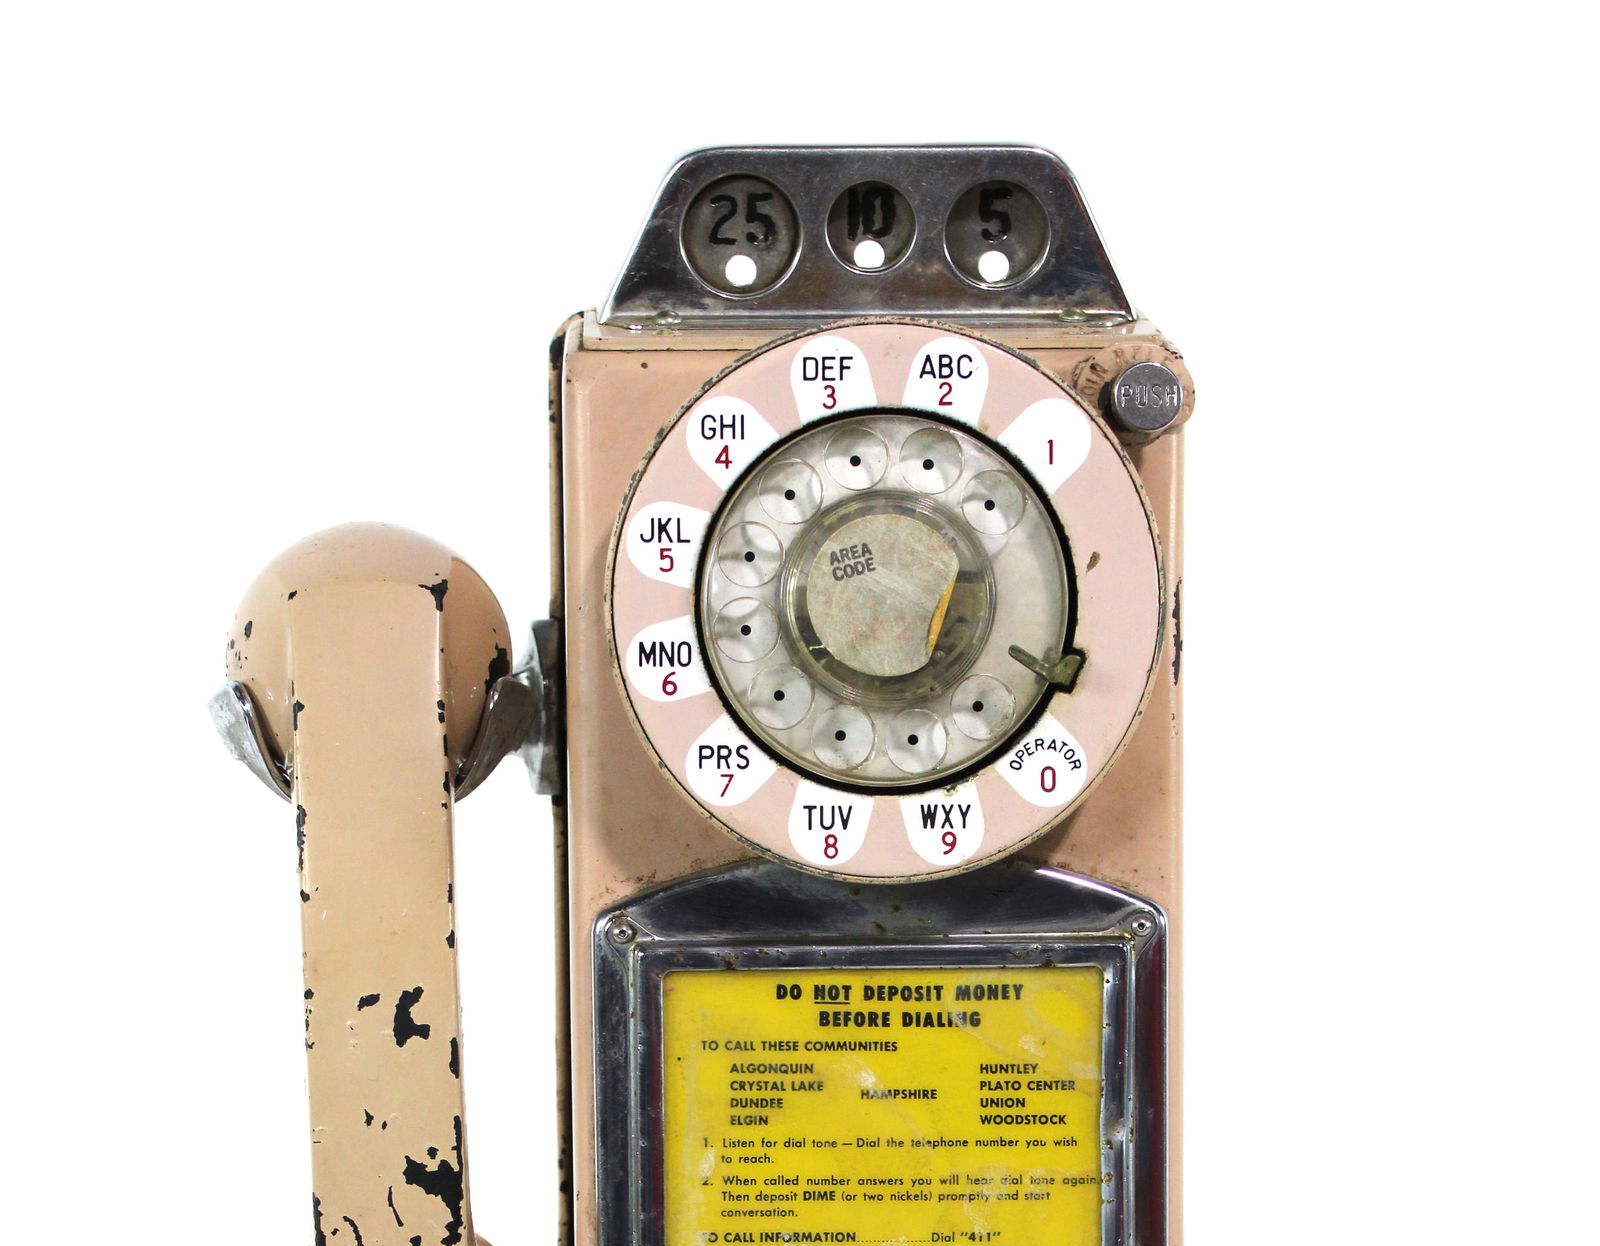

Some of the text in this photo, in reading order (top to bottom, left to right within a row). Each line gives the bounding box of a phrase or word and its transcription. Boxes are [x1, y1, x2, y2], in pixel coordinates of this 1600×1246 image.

[709, 192, 777, 245] 25
[847, 187, 896, 241] 10
[978, 187, 1014, 243] 5
[802, 356, 854, 382] DEF
[919, 354, 973, 380] ABC
[822, 384, 837, 410] 3
[938, 381, 953, 406] 2
[1120, 384, 1178, 408] PUSH
[701, 414, 745, 441] GHI
[714, 444, 733, 470] 4
[1047, 439, 1054, 465] 1
[639, 517, 691, 544] JKL
[659, 547, 674, 573] 5
[830, 542, 873, 566] AREA
[832, 557, 877, 581] CODE
[638, 640, 692, 668] MNO
[661, 671, 678, 696] 6
[698, 744, 750, 770] PRS
[1008, 739, 1083, 773] OPERATOR
[720, 773, 735, 798] 7
[1040, 765, 1057, 793] 0
[802, 805, 853, 831] TUV
[920, 803, 971, 830] WXY
[823, 833, 839, 860] 8
[941, 831, 957, 855] 9
[775, 983, 1024, 1002] DO NOT DEPOSIT MONEY
[818, 1010, 982, 1028] BEFORE DIALING
[700, 1039, 898, 1052] TO CALL THESE COMMUNITIES
[729, 1062, 814, 1075] ALGONQUIN
[979, 1063, 1039, 1075] HUNTLEY
[729, 1080, 824, 1092] CRYSTAL LAKE
[860, 1088, 938, 1100] HAMPSHIRE
[979, 1079, 1076, 1092] PLATO CENTER
[730, 1097, 784, 1109] DUNDEE
[979, 1097, 1026, 1109] UNION
[729, 1114, 769, 1126] ELGIN
[979, 1114, 1067, 1126] WOODSTOCK
[703, 1136, 714, 1148] 1.
[722, 1137, 755, 1149] Listen
[761, 1136, 778, 1149] for
[783, 1136, 806, 1149] dial
[811, 1138, 838, 1149] tone
[856, 1136, 881, 1148] Dial
[886, 1136, 905, 1148] the
[910, 1136, 969, 1150] telephone
[975, 1135, 1020, 1148] number
[1025, 1139, 1047, 1150] you
[1052, 1136, 1078, 1147] wish
[720, 1152, 775, 1164] to reach.
[722, 1174, 757, 1186] When
[763, 1174, 800, 1186] called
[806, 1174, 851, 1186] number
[857, 1177, 904, 1186] answers
[910, 1177, 932, 1188] you
[938, 1173, 960, 1186] will
[966, 1173, 994, 1186] hear
[1000, 1173, 1023, 1186] dial
[1029, 1175, 1056, 1186] tone
[1062, 1175, 1099, 1189] again.
[721, 1189, 1051, 1204] Then deposit DIME (or two nickels) promptly and start
[720, 1206, 799, 1218] conversation.
[723, 1232, 756, 1244] CALL
[759, 1231, 856, 1244] INFORMATION
[931, 1231, 955, 1243] Dial
